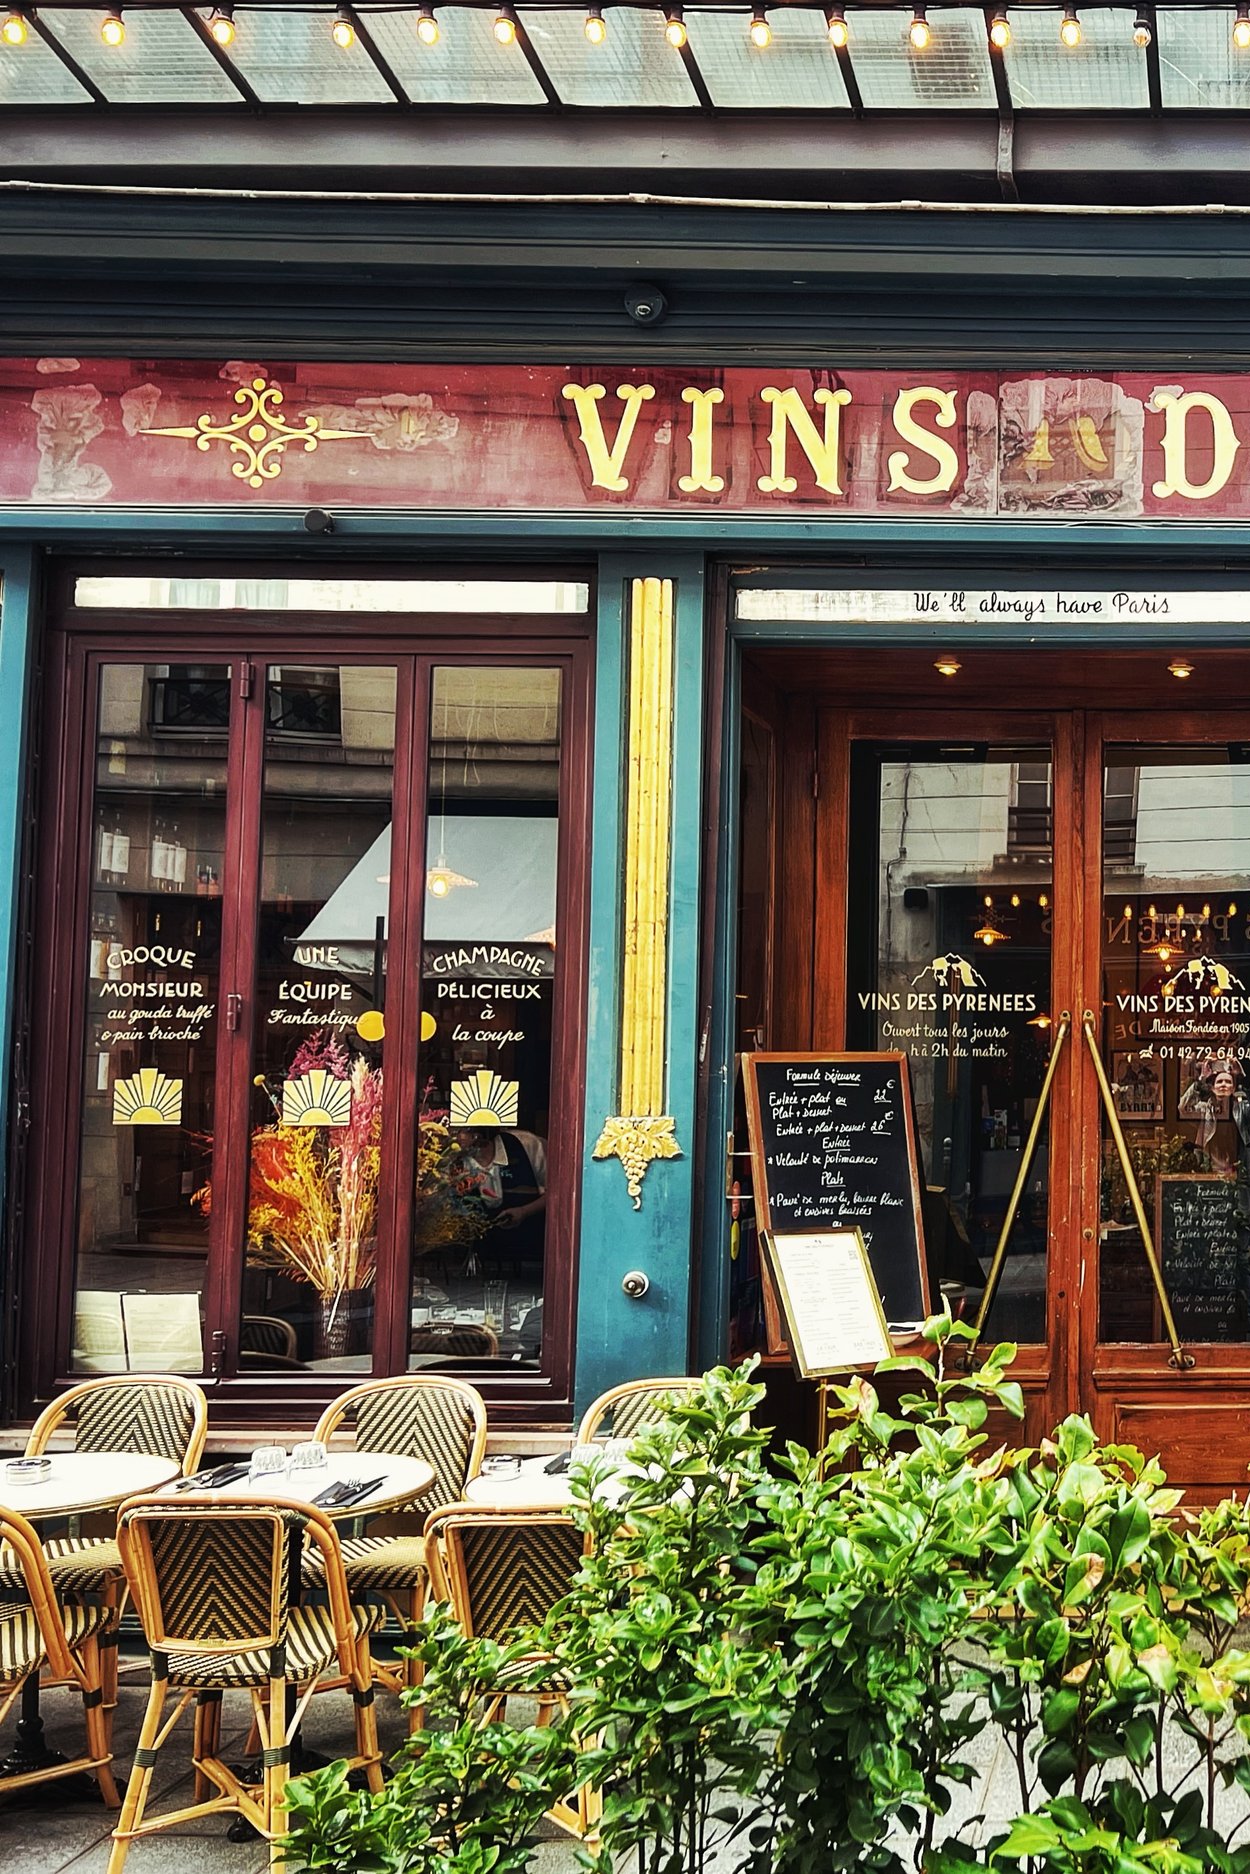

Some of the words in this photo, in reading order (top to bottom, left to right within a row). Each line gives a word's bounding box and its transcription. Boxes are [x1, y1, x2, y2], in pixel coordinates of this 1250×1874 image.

[561, 383, 958, 496] VINS
[913, 592, 967, 613] We'll
[979, 592, 1046, 622] always
[1057, 592, 1104, 614] have
[1112, 593, 1171, 614] Paris
[107, 945, 197, 969] CROQUE
[298, 946, 340, 964] UNE
[433, 946, 546, 977] CHAMPAGNE
[99, 982, 204, 998] MONSIEUR
[279, 980, 352, 1003] ÉQUIPE
[438, 981, 542, 999] DÉLICIEUX
[481, 1003, 495, 1020] à
[857, 993, 901, 1012] VINS
[907, 993, 937, 1012] DES
[943, 993, 1036, 1012] PYRENEES
[1116, 995, 1158, 1013] VINS
[1164, 995, 1195, 1013] DES
[107, 1009, 127, 1019] au
[128, 1004, 173, 1025] gouda
[175, 1004, 215, 1023] truffé
[267, 1008, 366, 1032] Fantastiqu
[882, 1020, 922, 1037] Ouvert
[923, 1023, 949, 1037] tous
[951, 1022, 969, 1038] les
[969, 1022, 1010, 1043] jours
[1149, 1018, 1185, 1033] Maison
[1186, 1019, 1219, 1033] Fondée
[1219, 1025, 1230, 1033] en
[1231, 1022, 1250, 1033] 1905
[111, 1027, 144, 1045] pain
[148, 1025, 204, 1041] brioché
[451, 1026, 469, 1041] la
[470, 1028, 525, 1050] coupe
[921, 1043, 929, 1057] à
[931, 1043, 949, 1057] 2h
[952, 1043, 969, 1057] du
[972, 1043, 1009, 1057] matin
[1160, 1046, 1173, 1060] 01
[1178, 1046, 1193, 1060] 42
[1196, 1046, 1212, 1060] 72
[1217, 1046, 1234, 1060] 64
[786, 1068, 821, 1080] Formule
[769, 1091, 798, 1106] Entrée
[808, 1091, 831, 1107] plat
[836, 1097, 847, 1105] ou
[772, 1106, 793, 1119] Plat
[776, 1122, 803, 1136] Entrée
[822, 1135, 851, 1149] Entrée
[821, 1171, 844, 1185] Plats
